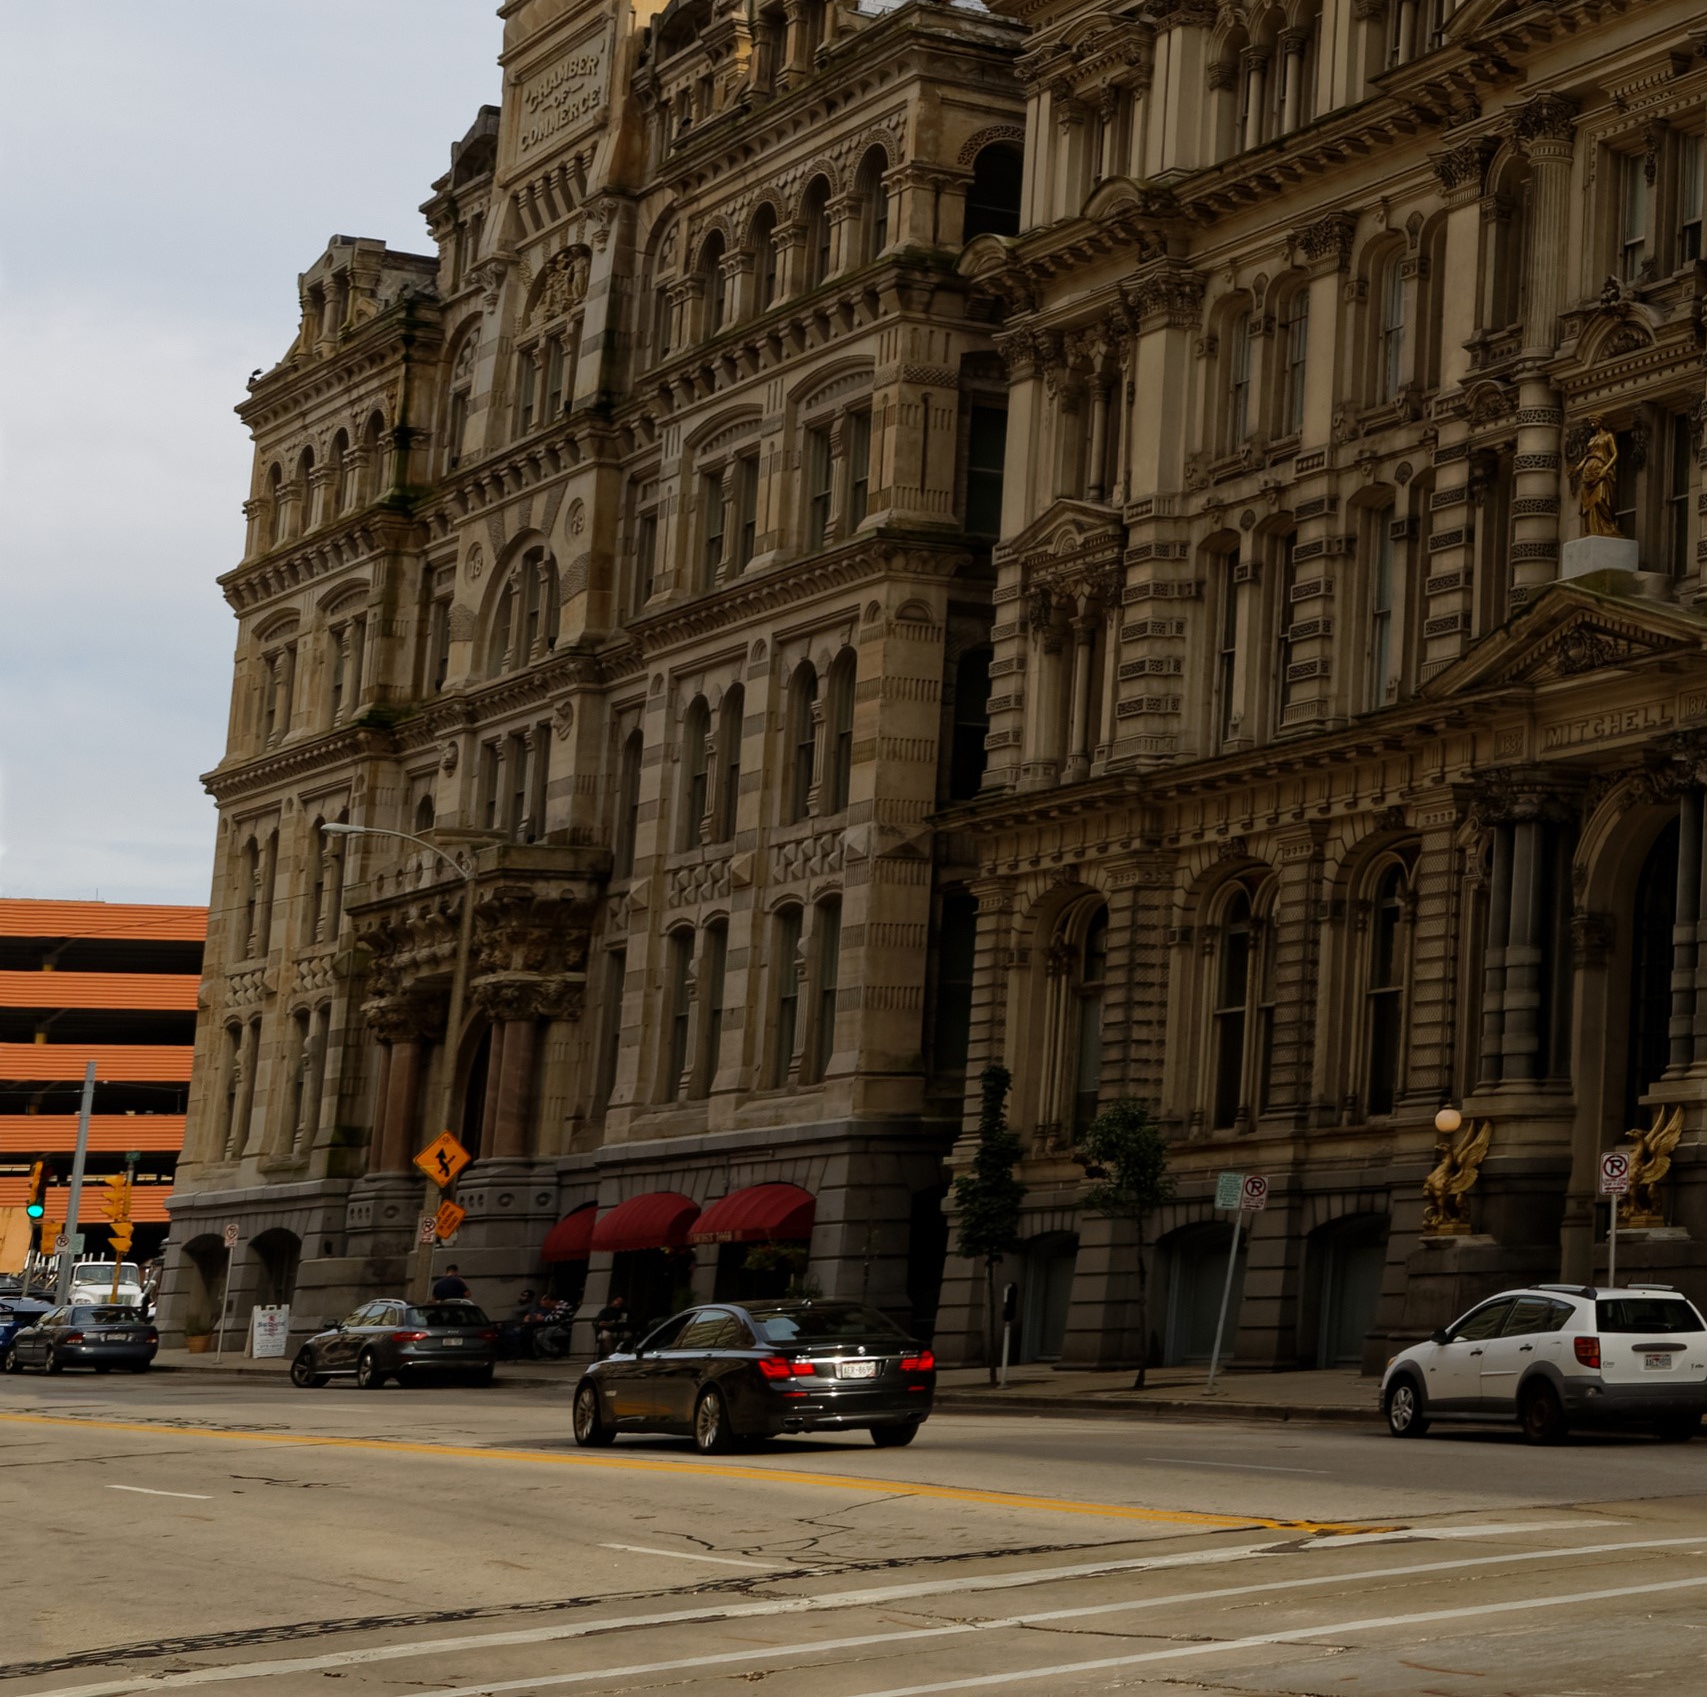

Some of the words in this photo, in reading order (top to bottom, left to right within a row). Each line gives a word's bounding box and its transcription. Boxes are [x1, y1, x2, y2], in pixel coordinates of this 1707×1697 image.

[530, 56, 599, 114] CHAMBER
[554, 91, 570, 108] OF
[521, 86, 601, 152] COMMERCE
[572, 515, 585, 536] 79
[470, 558, 483, 579] 18
[1545, 703, 1673, 747] MITCHELL
